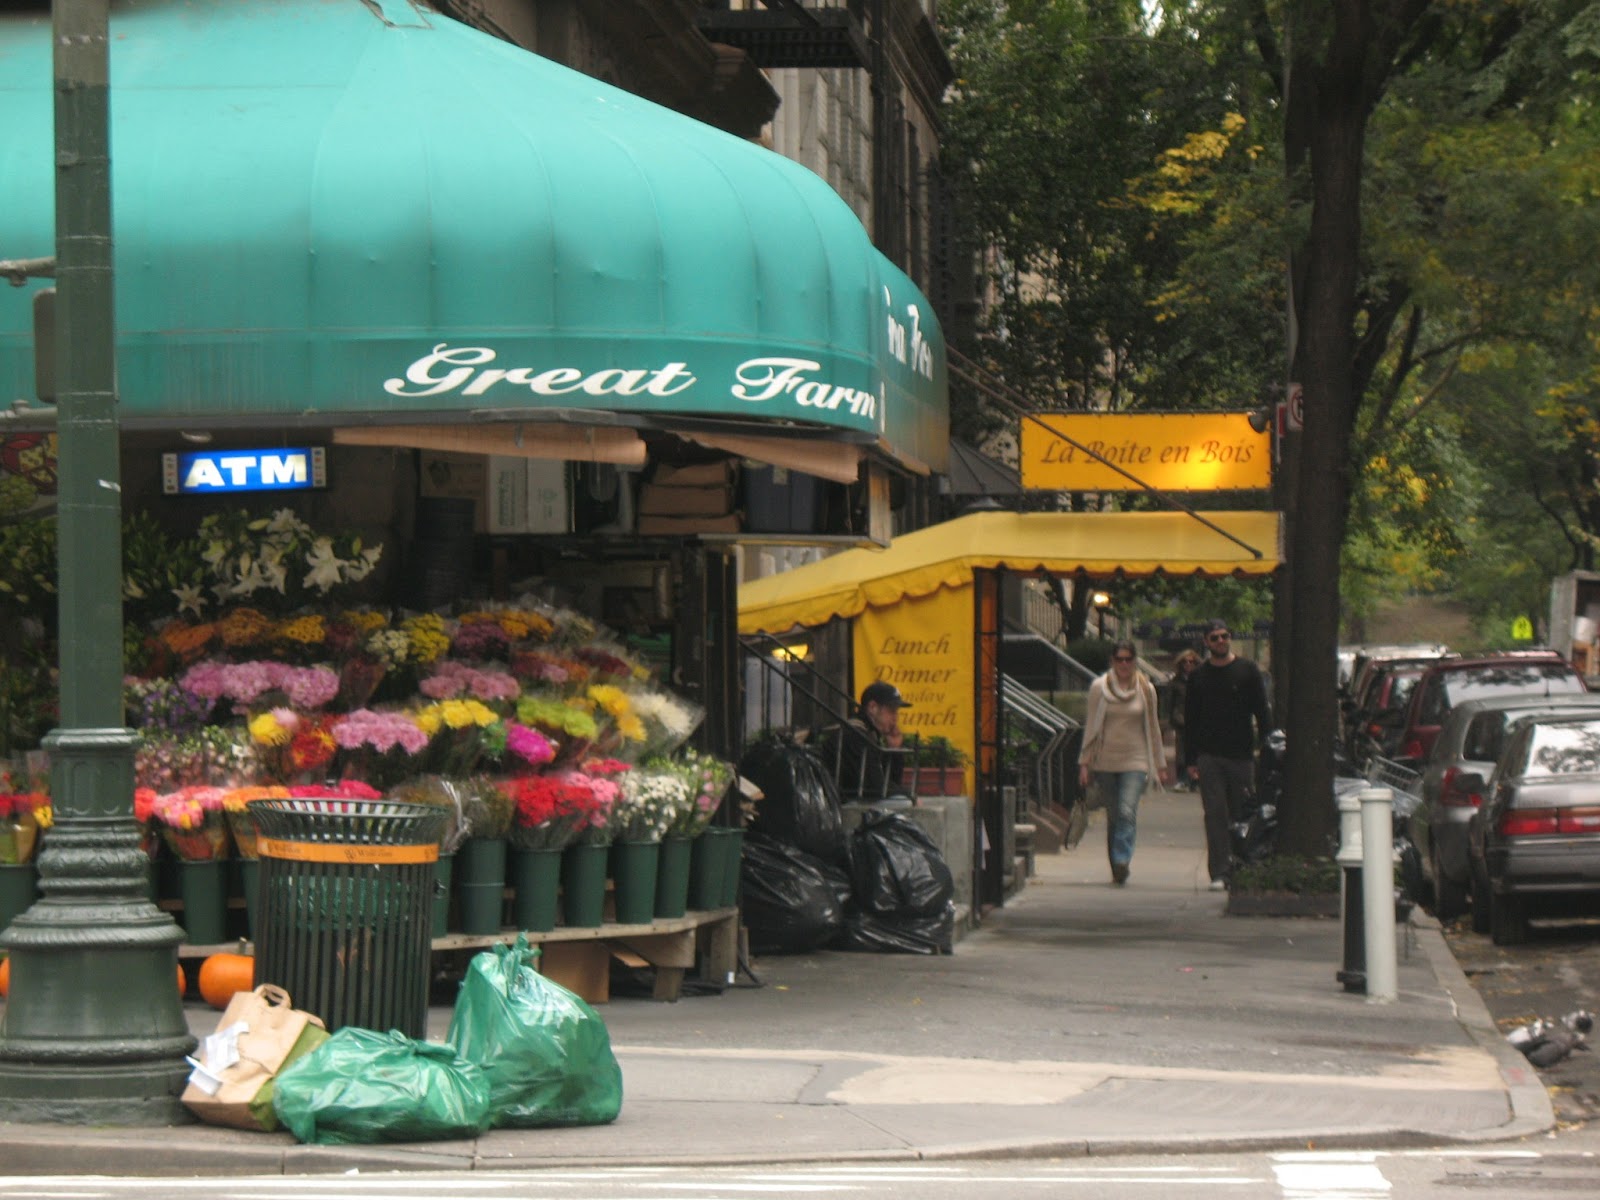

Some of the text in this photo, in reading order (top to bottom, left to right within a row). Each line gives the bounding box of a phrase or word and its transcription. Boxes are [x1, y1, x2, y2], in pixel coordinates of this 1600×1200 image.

[383, 342, 697, 397] Great
[730, 356, 877, 420] Farm
[1041, 440, 1075, 465] La
[1159, 444, 1190, 464] en
[1200, 439, 1255, 464] Bois
[184, 453, 308, 487] ATM
[880, 633, 951, 655] Lunch
[874, 664, 957, 684] Dinner
